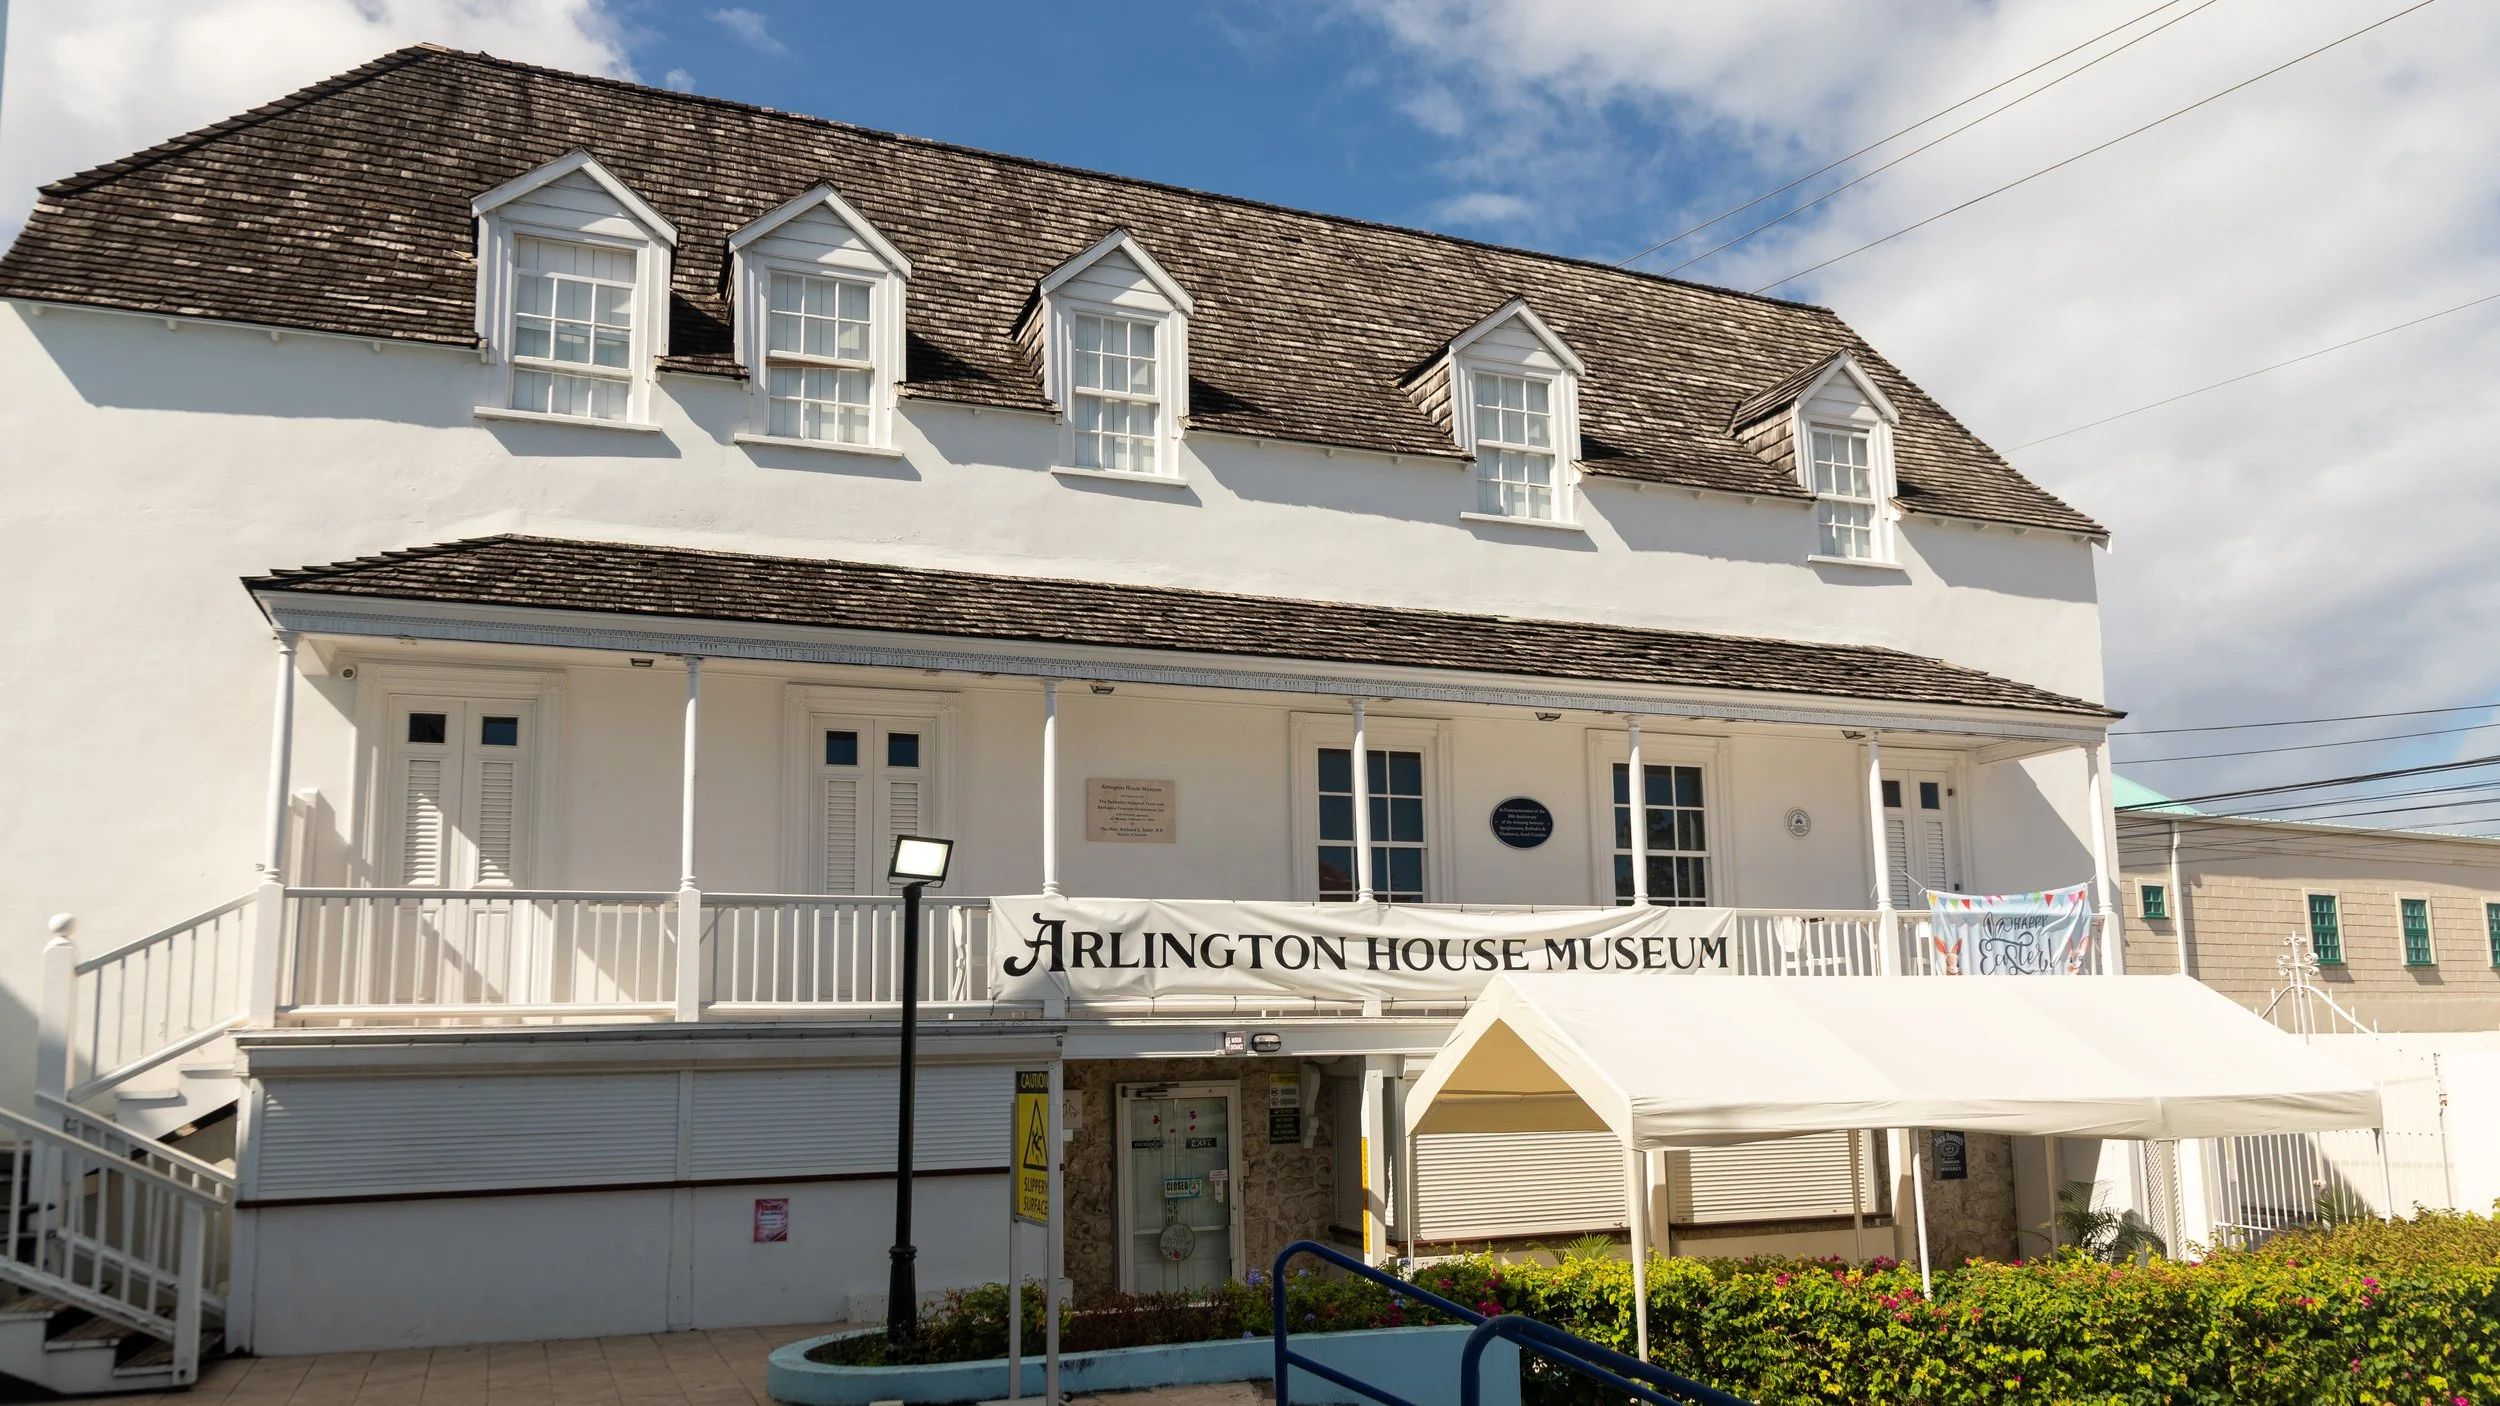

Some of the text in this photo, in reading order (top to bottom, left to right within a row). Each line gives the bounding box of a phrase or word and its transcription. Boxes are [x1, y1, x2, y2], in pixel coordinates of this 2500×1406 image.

[2013, 915, 2049, 930] HAPPY
[1002, 912, 1729, 977] ARLINGTON HOUSE MUSEUM
[1021, 1073, 1048, 1089] CAUTION
[1191, 1138, 1212, 1147] EXIT
[1166, 1181, 1189, 1191] CLOSED
[1023, 1196, 1048, 1215] SURFACE
